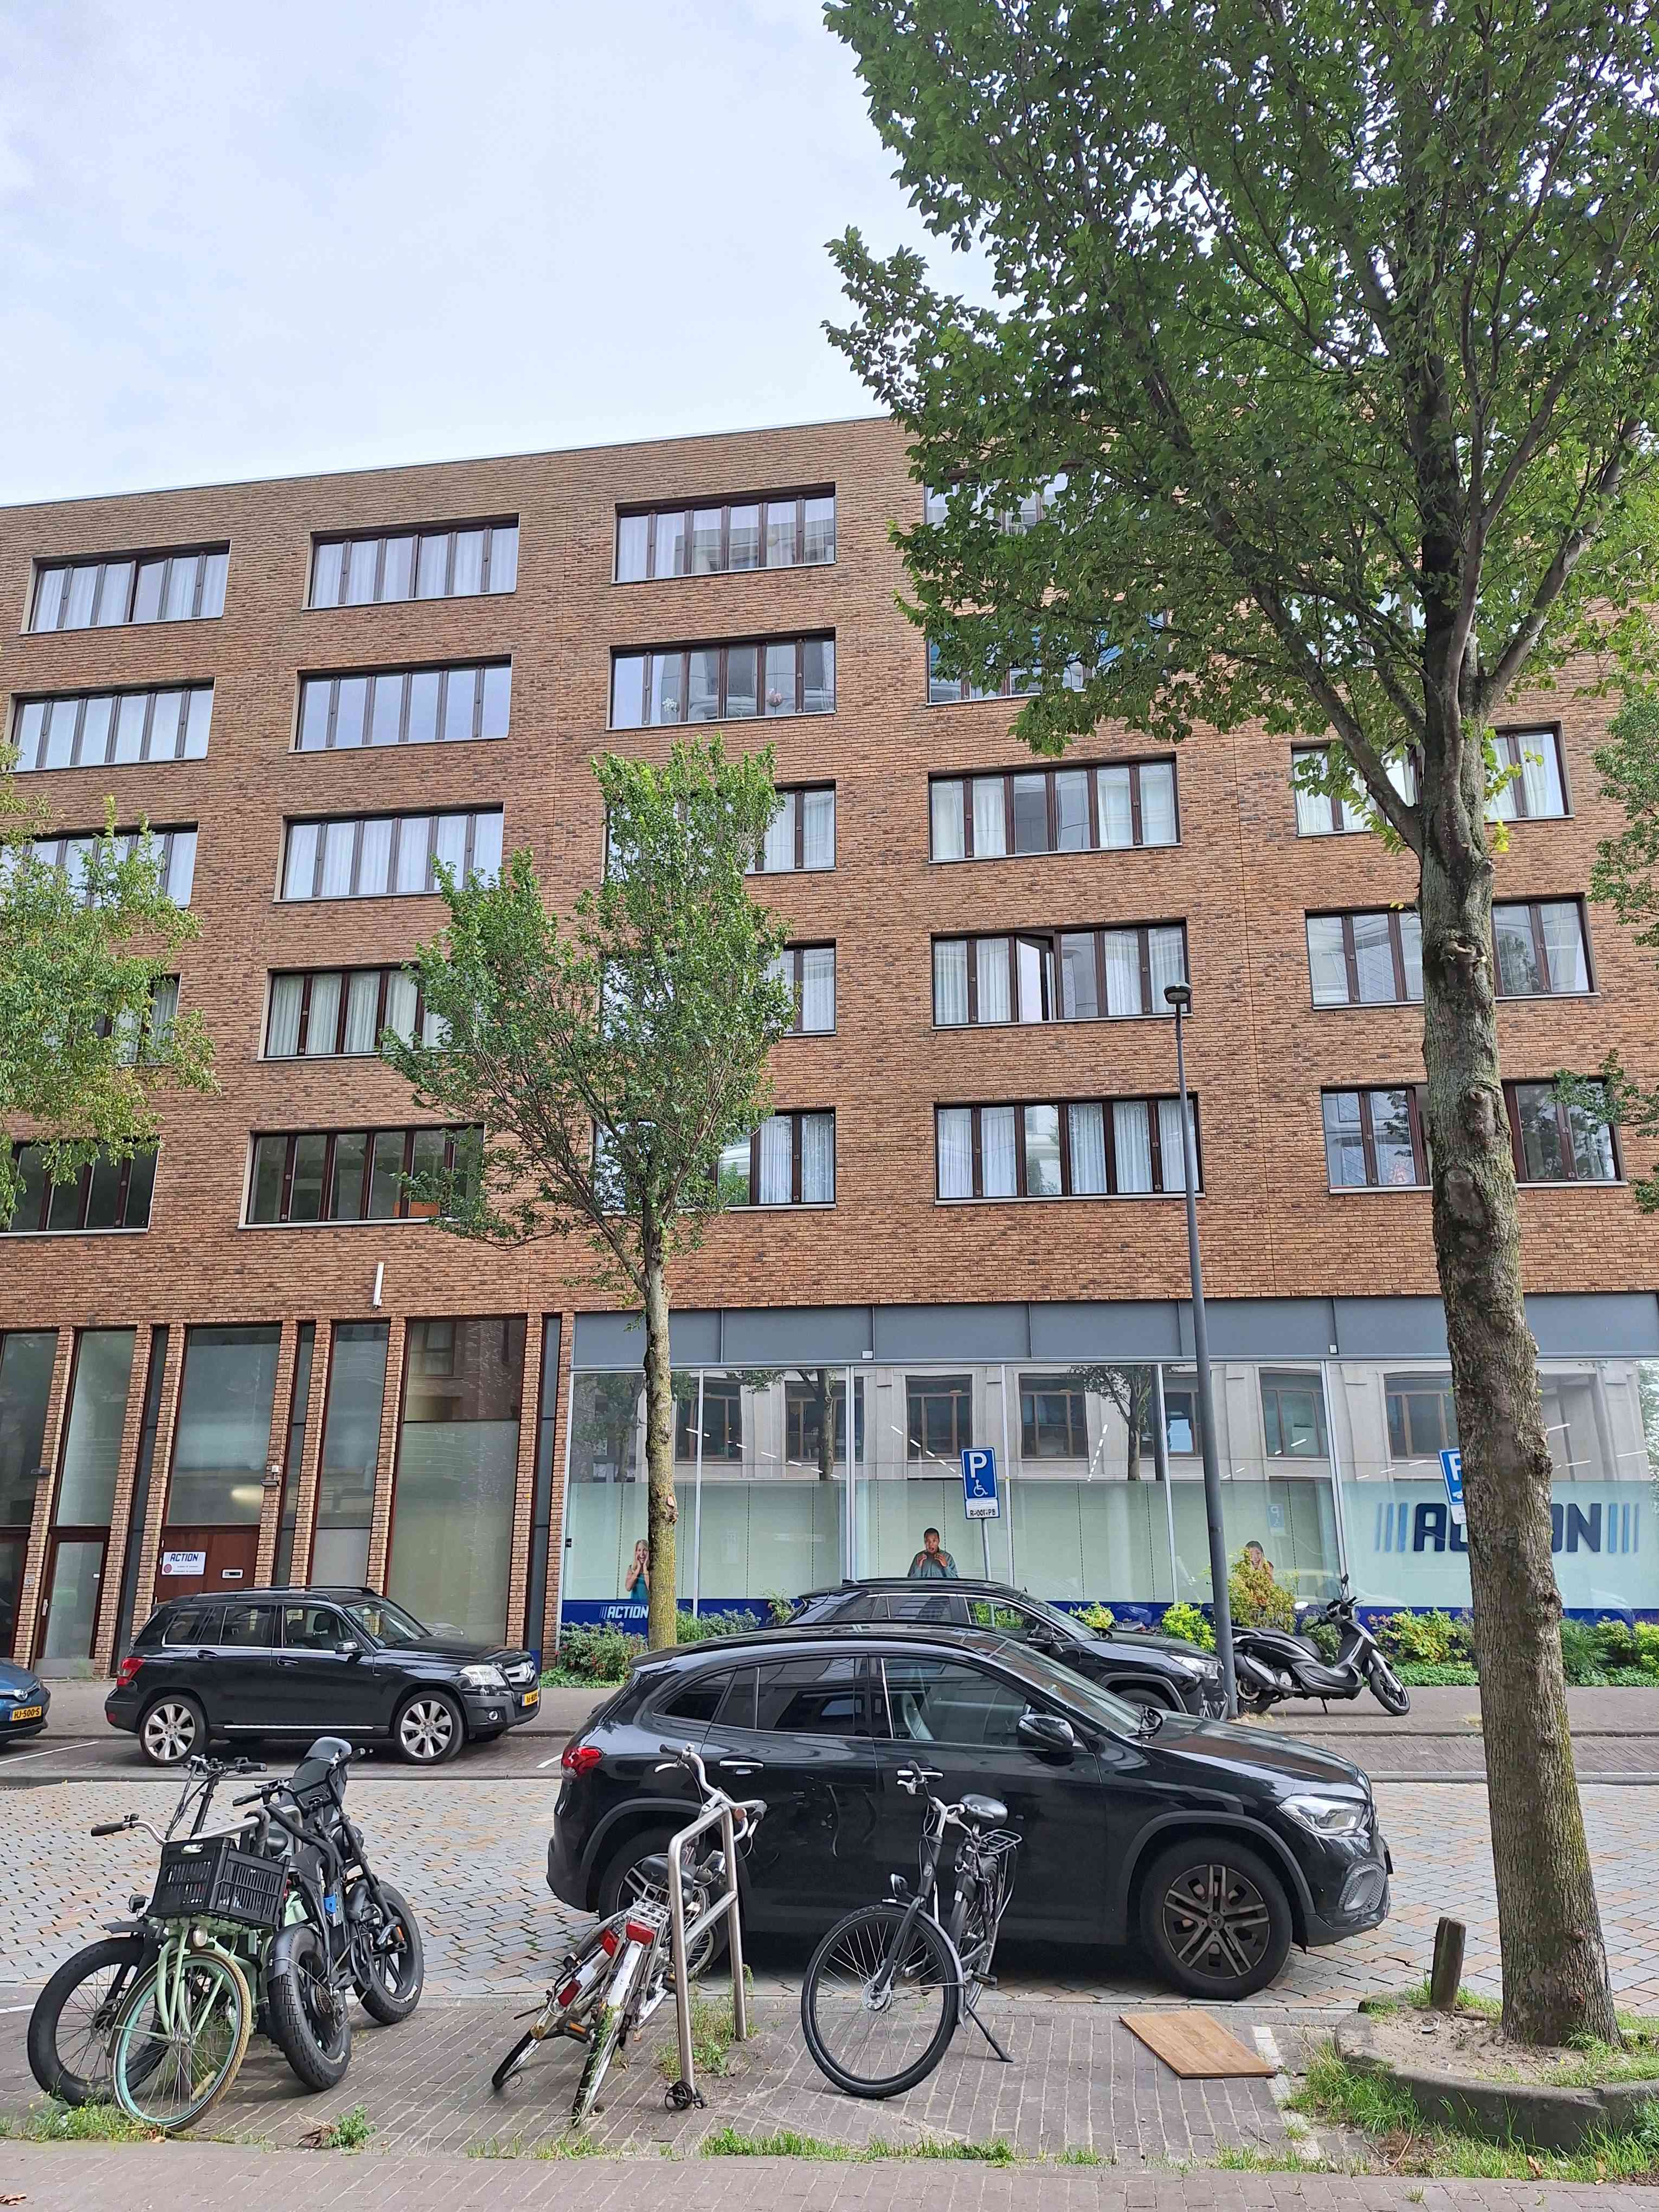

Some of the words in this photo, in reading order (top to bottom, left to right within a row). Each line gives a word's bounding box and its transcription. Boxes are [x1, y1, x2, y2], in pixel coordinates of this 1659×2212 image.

[969, 1452, 987, 1478] P
[170, 1553, 199, 1562] ACTION
[607, 1606, 649, 1618] ACTION
[14, 1708, 40, 1719] HJ-500-S
